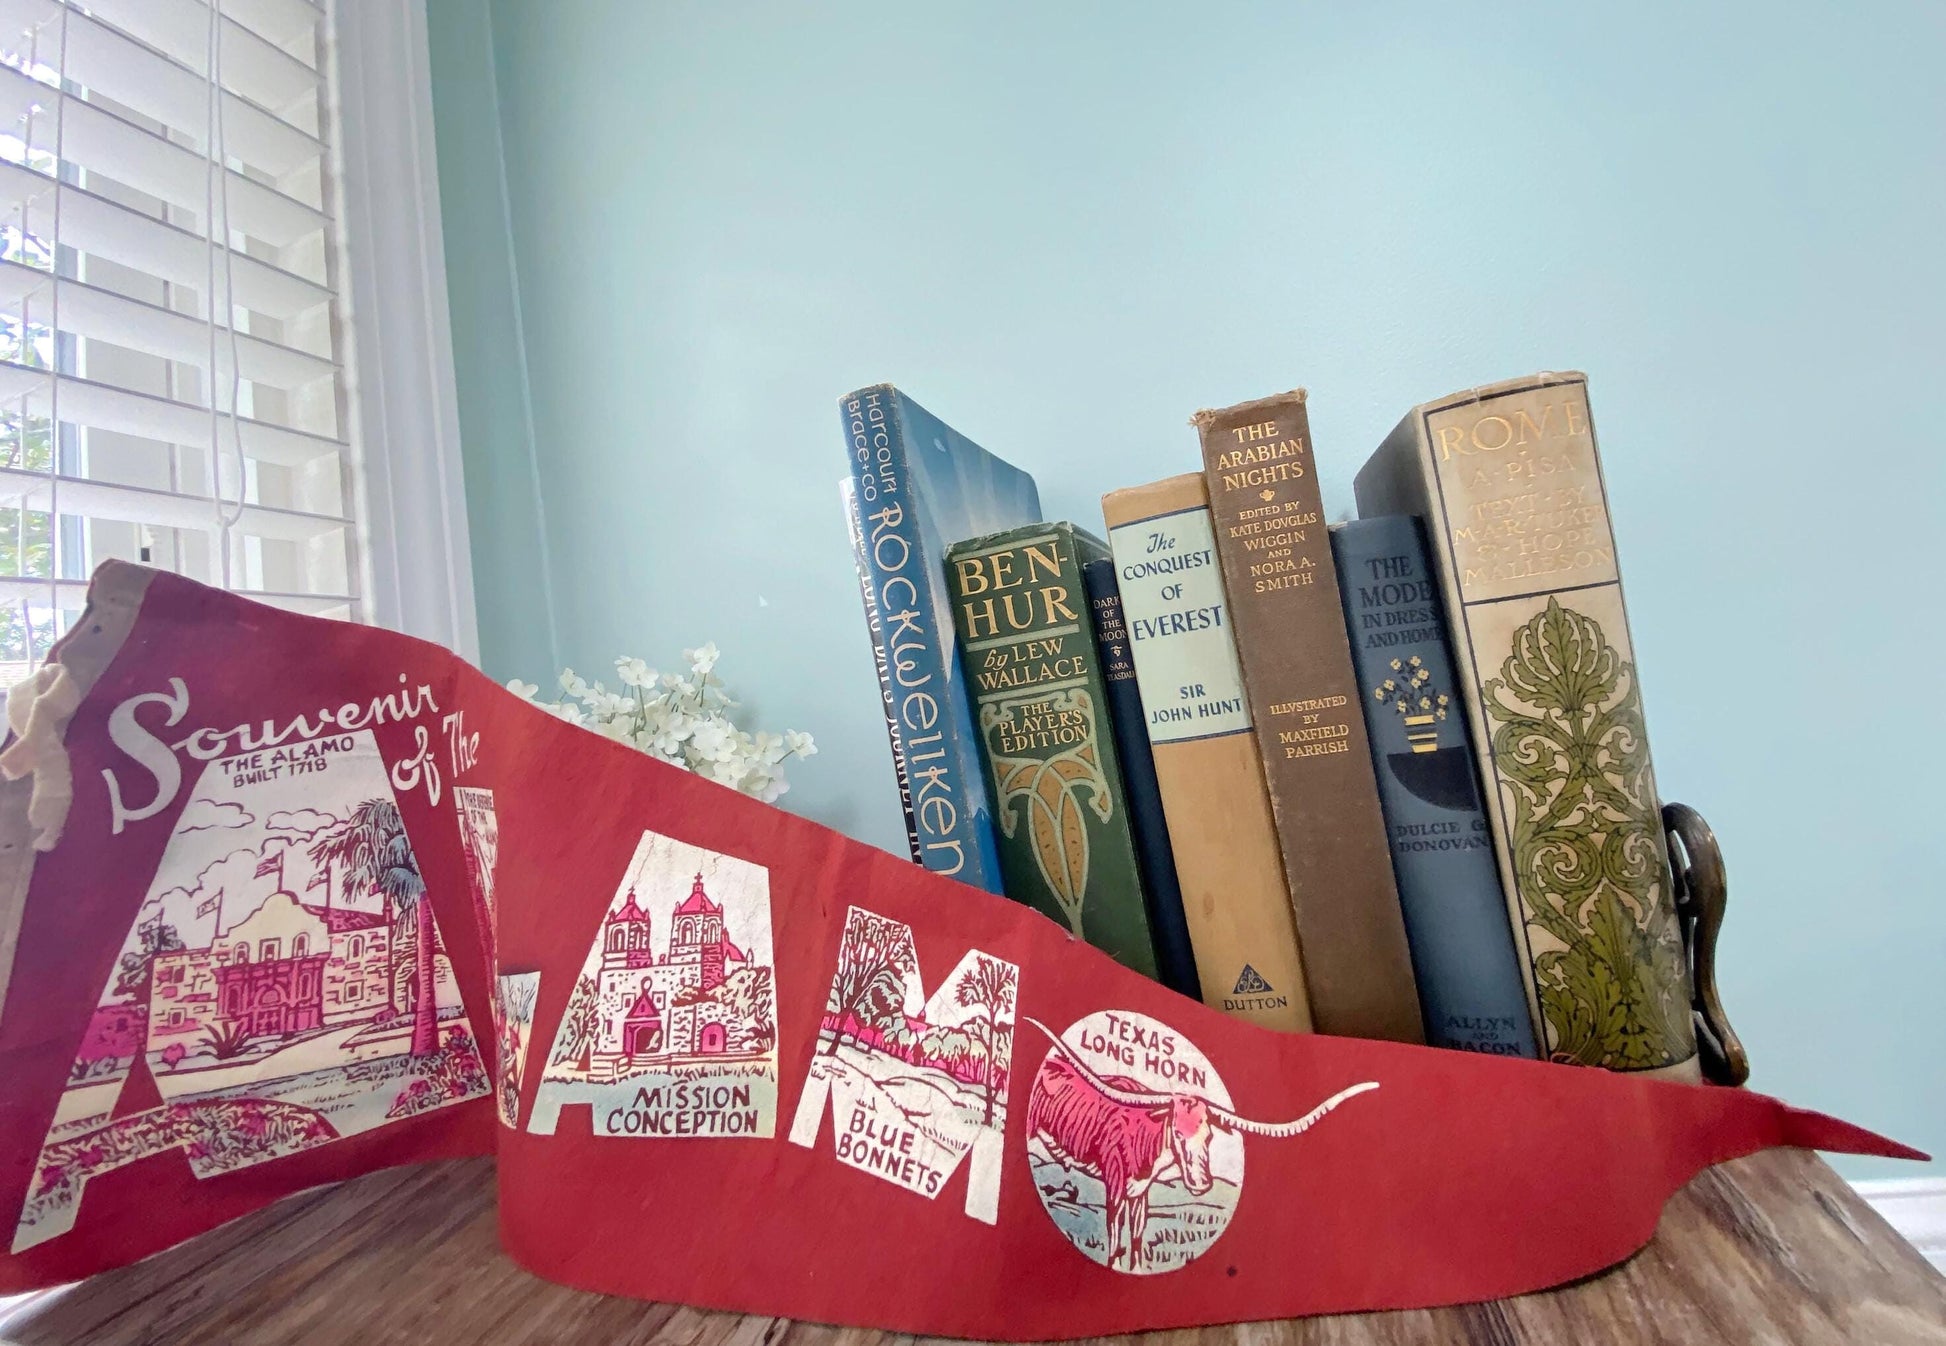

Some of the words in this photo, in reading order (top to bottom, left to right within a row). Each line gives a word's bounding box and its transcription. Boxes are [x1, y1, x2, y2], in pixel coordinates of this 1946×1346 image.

[1233, 421, 1279, 442] THE
[866, 393, 897, 494] Harcourt
[1217, 438, 1303, 470] ARABIAN
[1223, 462, 1304, 491] NIGHTS
[1239, 505, 1280, 520] EDITED
[1284, 501, 1299, 511] BY
[1230, 523, 1262, 538] KATE
[1244, 531, 1305, 551] WIGGIN
[1146, 533, 1175, 553] The
[1267, 548, 1291, 558] AND
[1123, 550, 1211, 581] CONQUEST
[1250, 561, 1296, 577] NORA
[1300, 557, 1316, 567] A.
[1365, 556, 1413, 580] THE
[1161, 583, 1183, 600] OF
[1255, 572, 1313, 593] SMITH
[1093, 596, 1120, 609] DARK
[1359, 581, 1432, 607] MODE
[963, 585, 1078, 637] HUR
[1103, 609, 1115, 618] OF
[1361, 614, 1382, 629] IN
[1102, 619, 1121, 629] THE
[1132, 605, 1222, 641] EVEREST
[1099, 629, 1127, 642] MOON
[1365, 631, 1399, 648] AND
[984, 649, 1008, 670] by
[1012, 638, 1064, 661] LEW
[976, 656, 1087, 690] WALLACE
[1110, 661, 1128, 670] SARA
[1180, 684, 1206, 699] SIR
[1020, 702, 1052, 716] THE
[1152, 706, 1193, 724] JOHN
[1198, 698, 1242, 718] HUNT
[1303, 714, 1320, 724] BY
[999, 709, 1083, 737] PLAYER'S
[1279, 724, 1349, 743] MAXFIELD
[1001, 725, 1088, 752] EDITION
[1286, 740, 1349, 758] PARRISH
[101, 672, 439, 835] Souvenir
[220, 755, 262, 775] THE
[271, 736, 355, 765] ALAMO
[392, 726, 441, 806] of
[443, 711, 480, 777] The
[232, 767, 280, 789] BUILT
[289, 759, 328, 777] 1718
[1397, 822, 1460, 837] DULCIE
[1399, 837, 1490, 852] DONOVAN
[1224, 996, 1287, 1010] DUTTON
[1105, 1013, 1175, 1055] TEXAS
[1080, 1030, 1135, 1065] LONG
[1145, 1053, 1207, 1089] HORN
[632, 1084, 750, 1109] MISSION
[607, 1107, 758, 1135] CONCEPTION
[850, 1107, 915, 1154] BLUE
[837, 1132, 943, 1194] BONNETS
